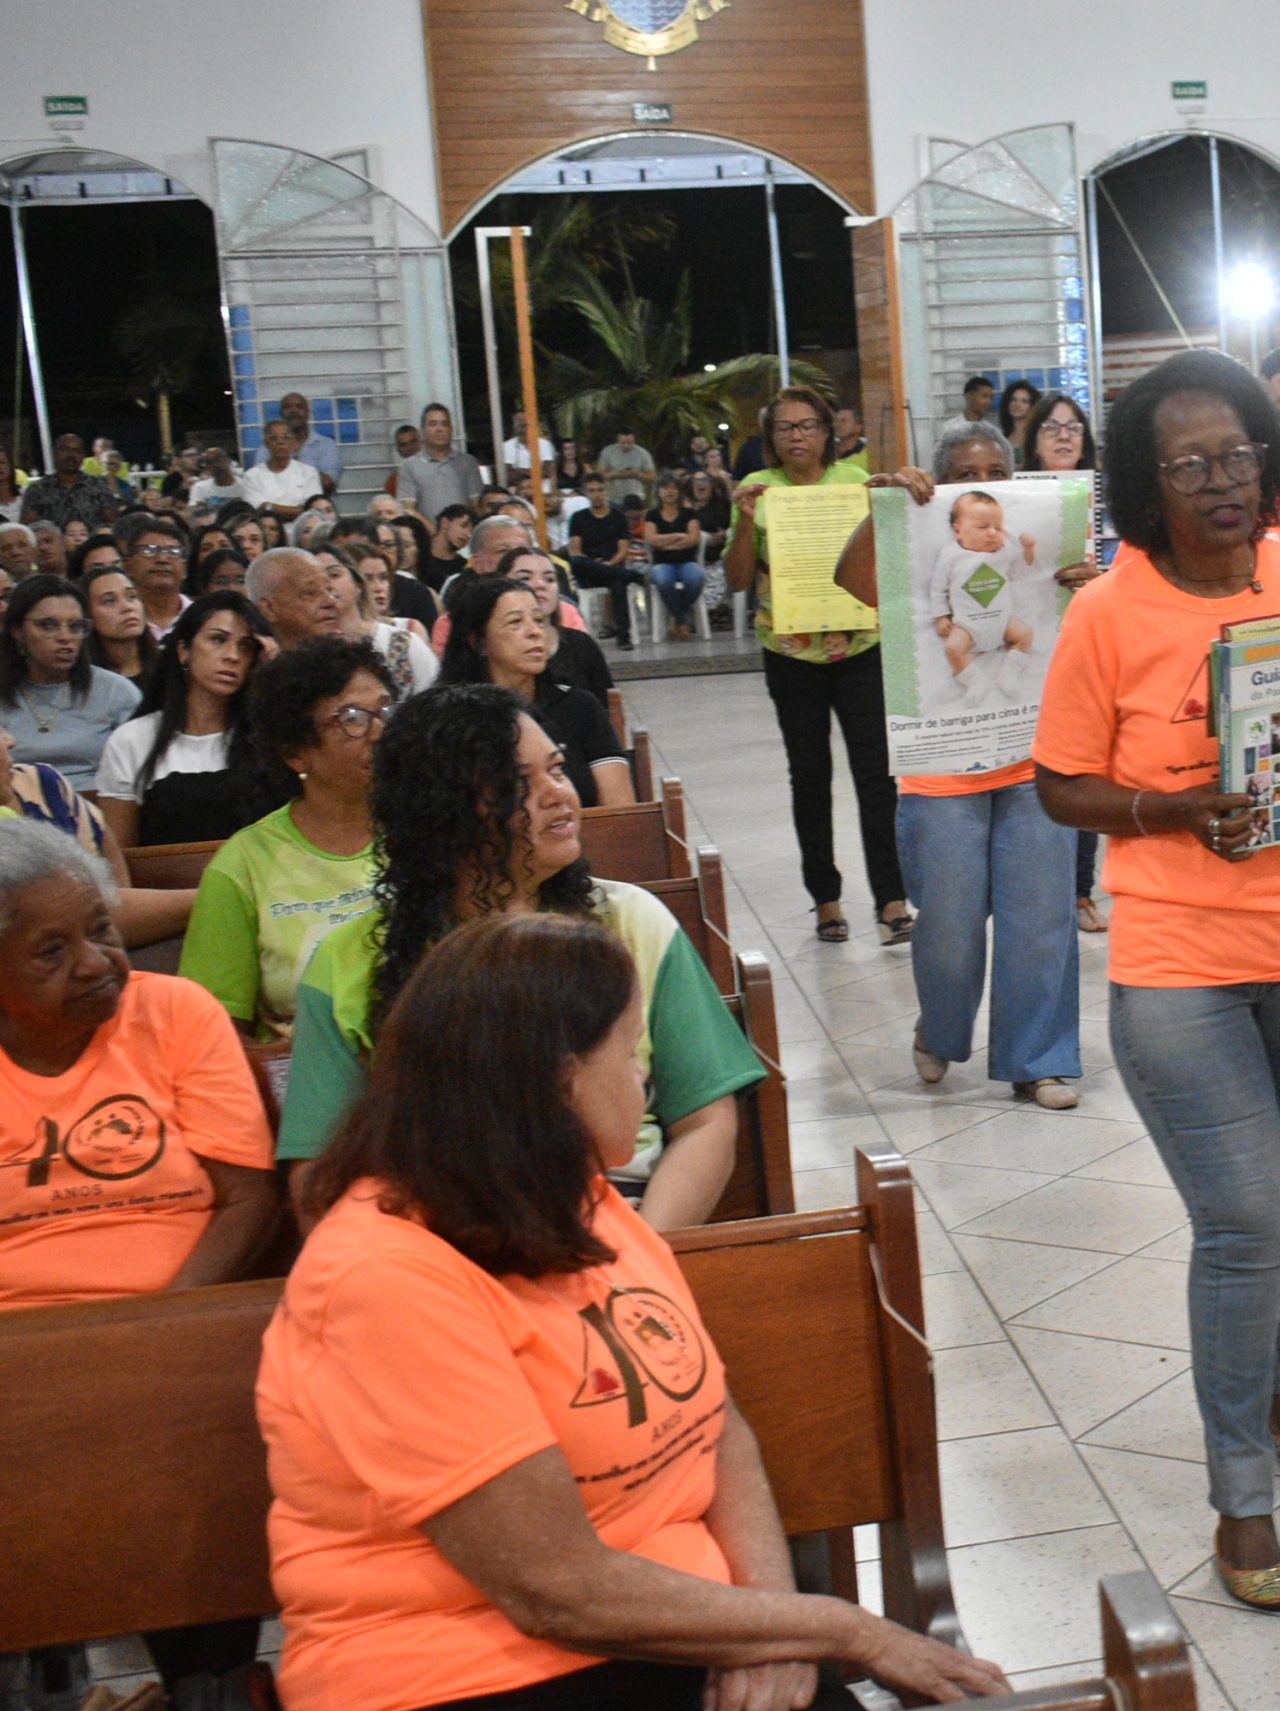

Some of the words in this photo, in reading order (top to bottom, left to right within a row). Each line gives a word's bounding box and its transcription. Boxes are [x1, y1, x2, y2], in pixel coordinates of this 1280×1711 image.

[890, 721, 923, 732] Dormir
[925, 718, 938, 728] de
[940, 715, 973, 727] barriga
[976, 712, 997, 723] para
[998, 707, 1020, 719] cima
[53, 1184, 103, 1201] ANOS
